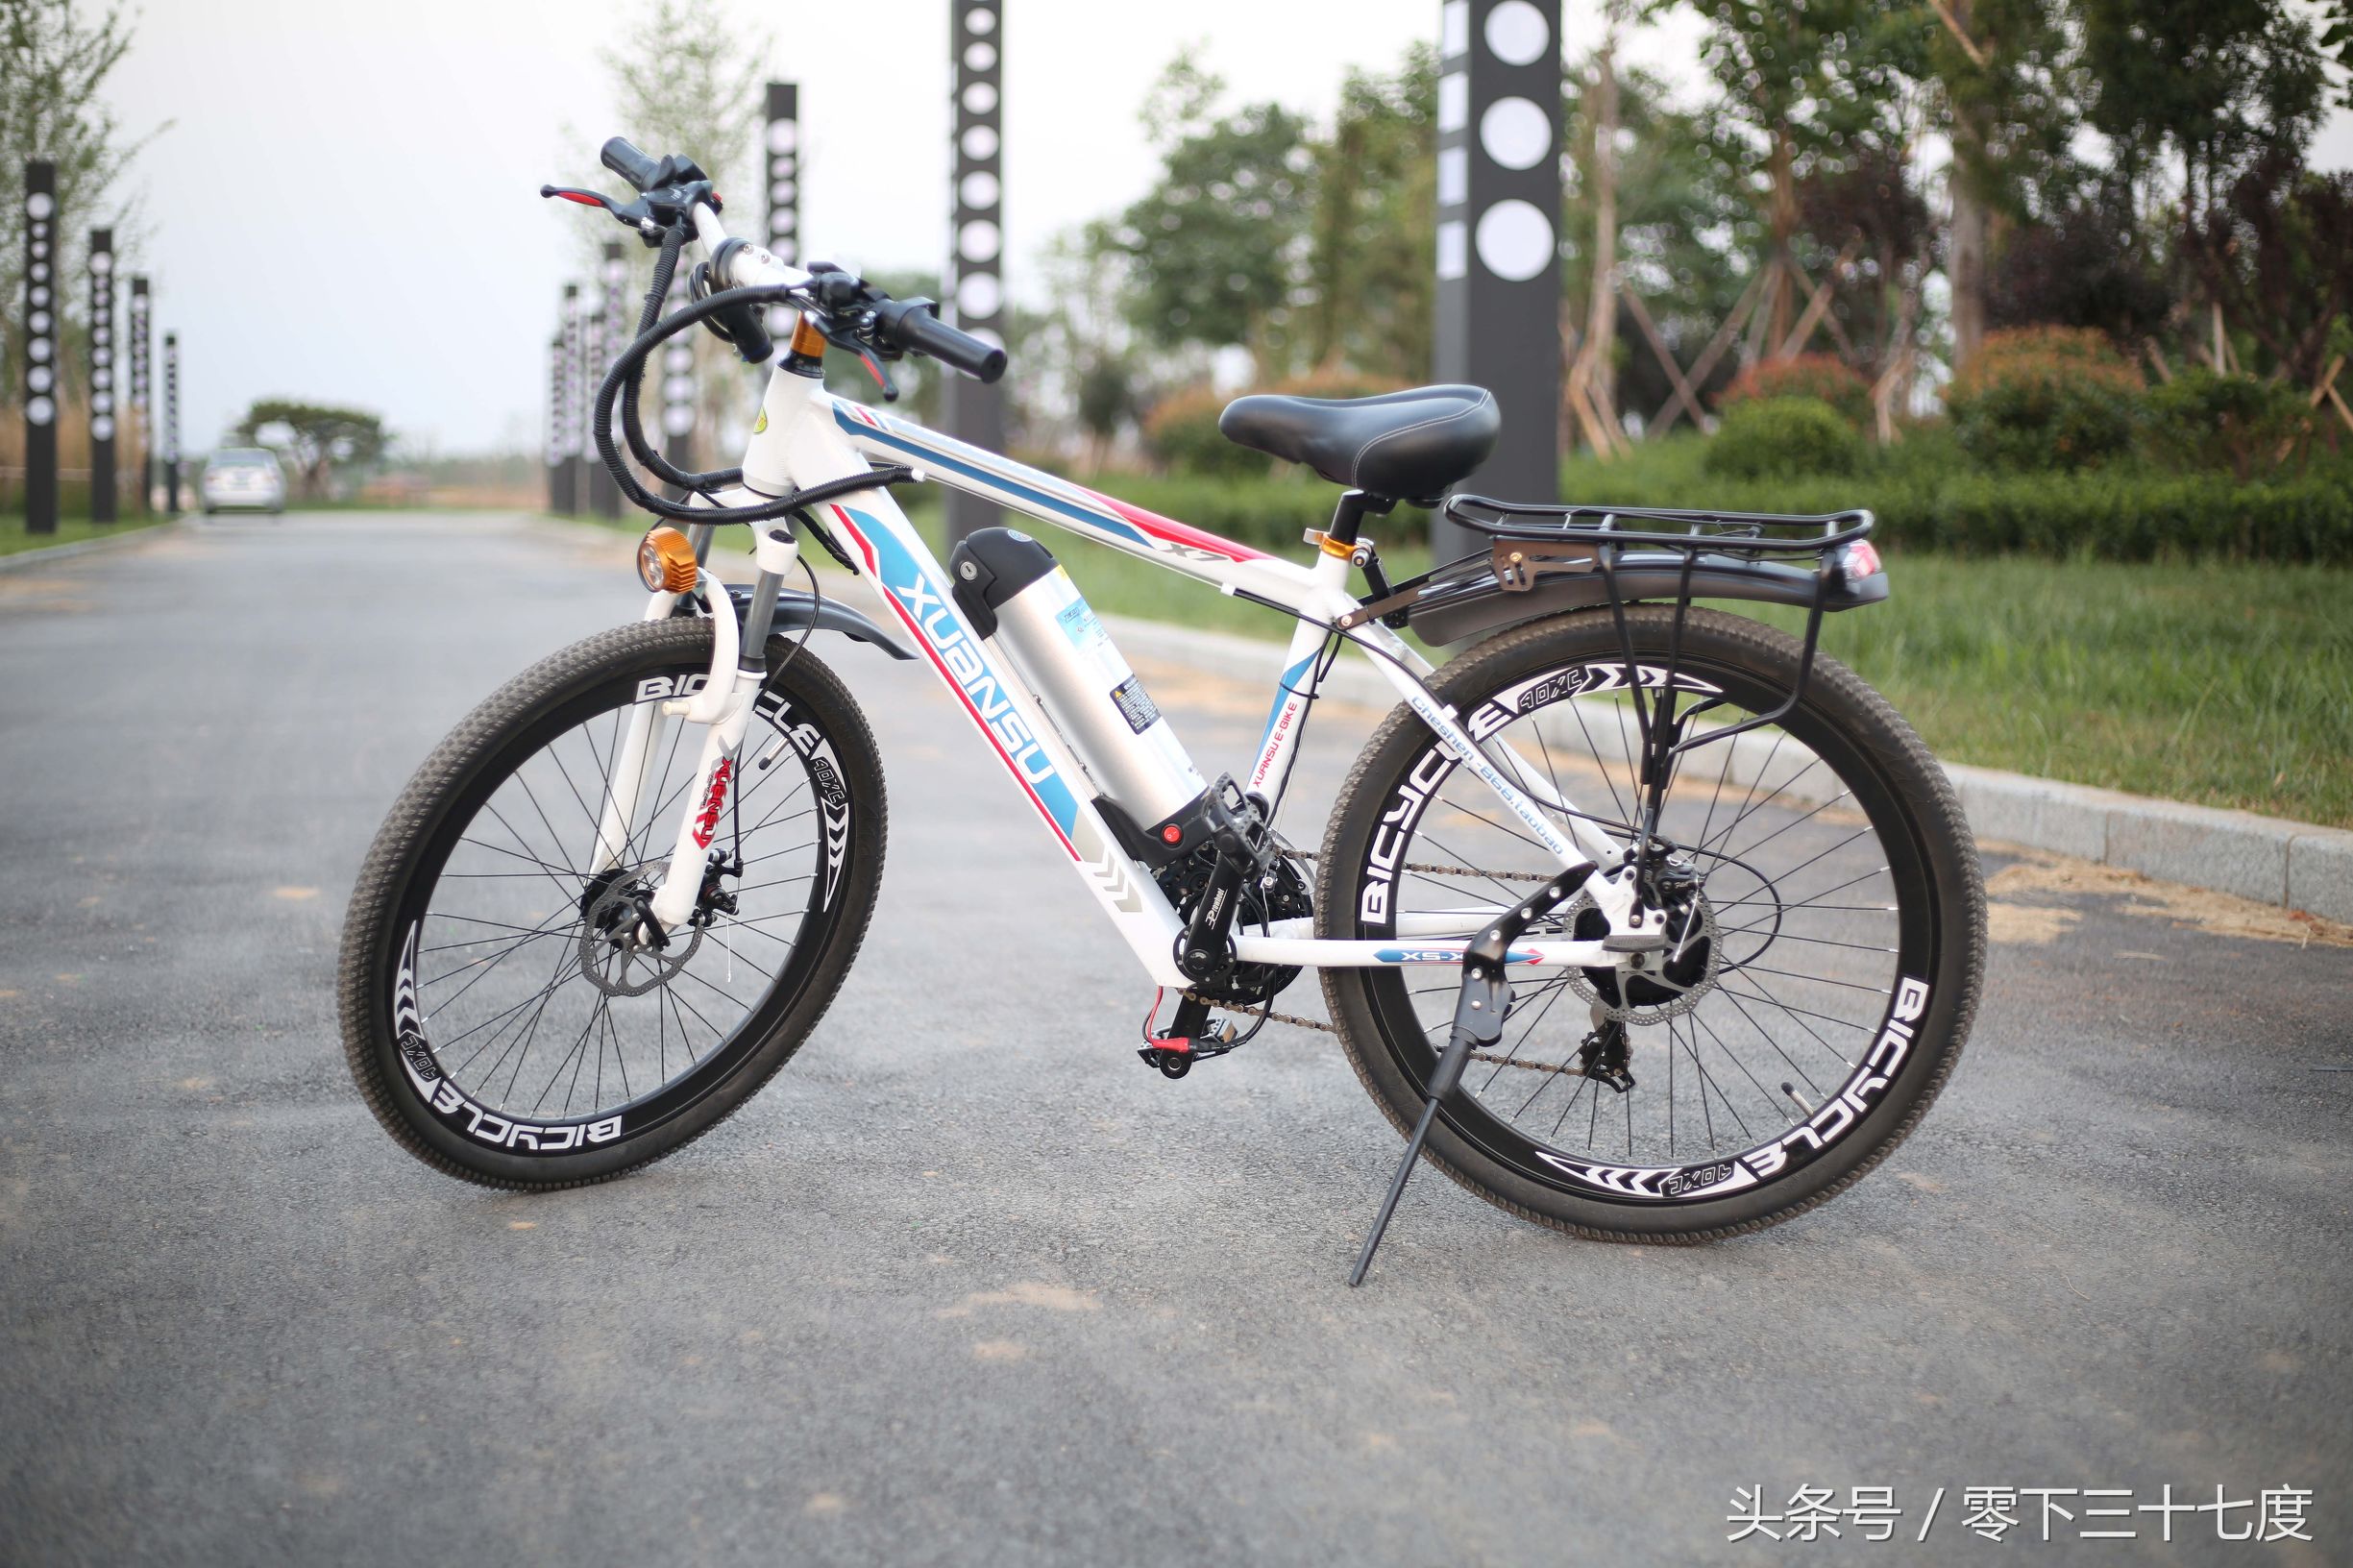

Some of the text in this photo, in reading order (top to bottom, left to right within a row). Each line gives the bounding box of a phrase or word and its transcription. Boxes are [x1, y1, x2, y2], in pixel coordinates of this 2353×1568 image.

[635, 674, 821, 757] BICCLE
[1253, 701, 1297, 788] XUANSU E-BIKE
[432, 1080, 623, 1150] BICYCLE
[1742, 977, 1929, 1177] BICYCLE
